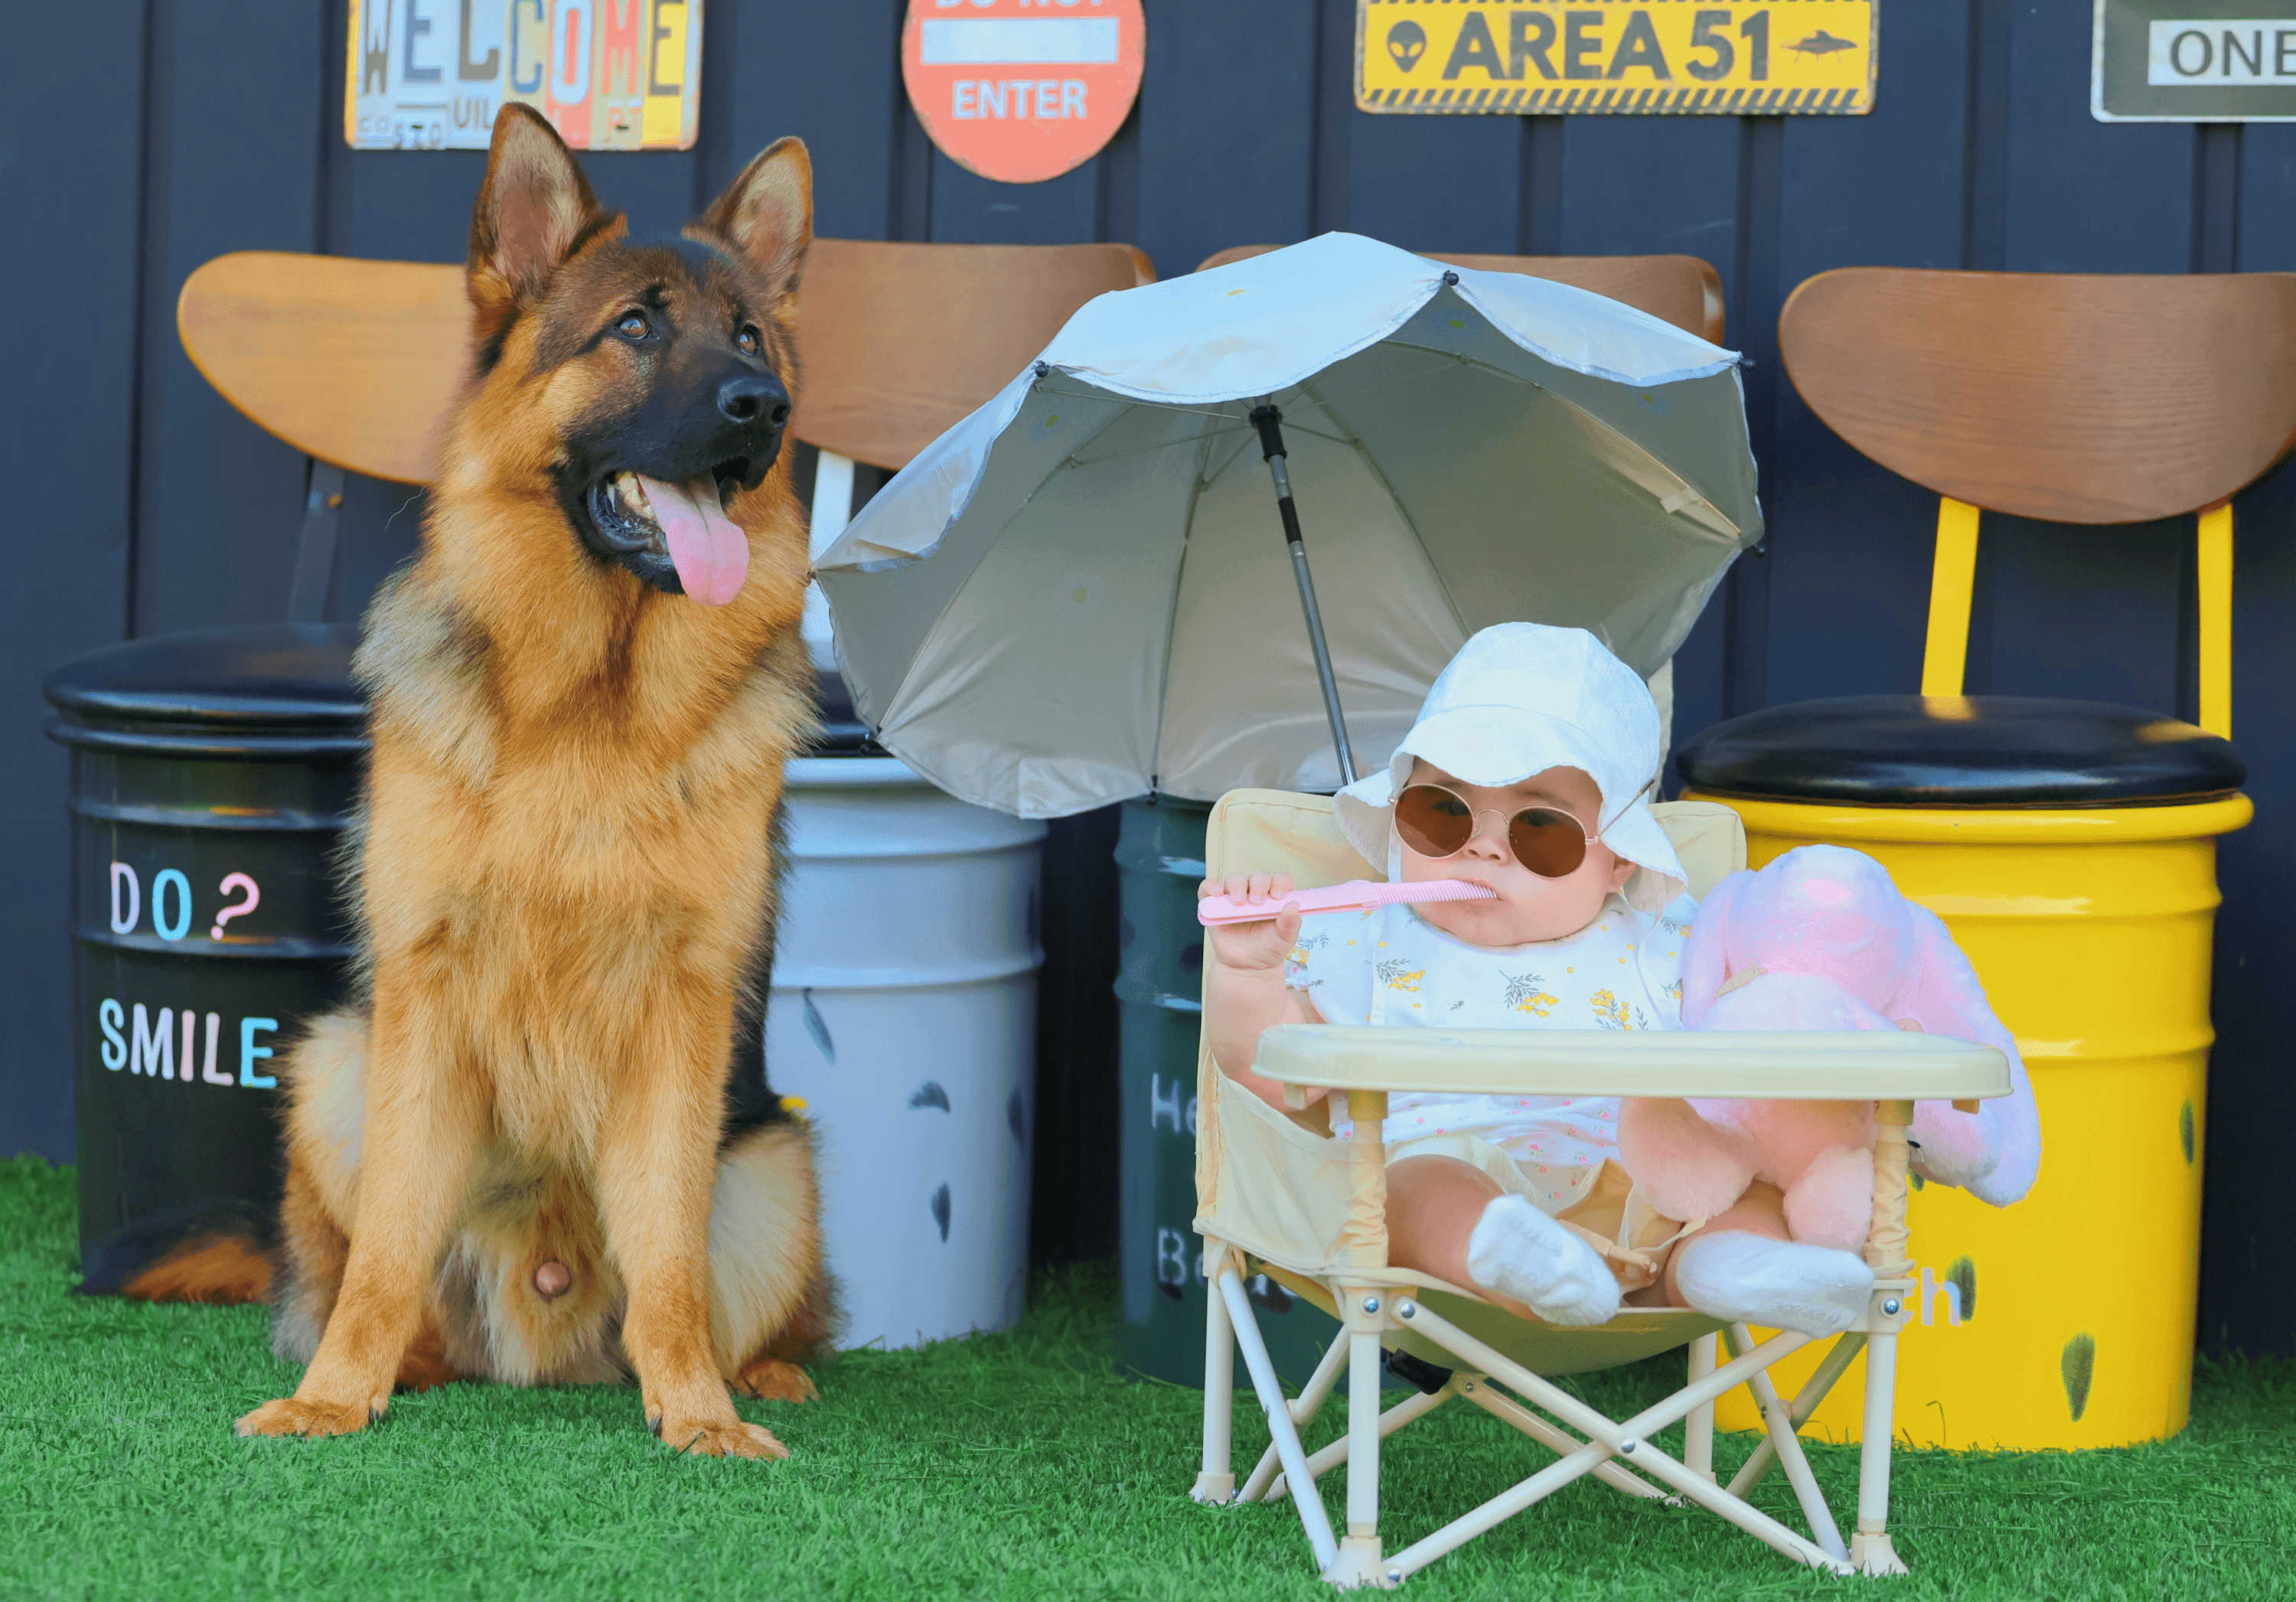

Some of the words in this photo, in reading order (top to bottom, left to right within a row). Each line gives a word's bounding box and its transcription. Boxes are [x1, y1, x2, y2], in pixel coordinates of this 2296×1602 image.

[363, 0, 686, 106] WELCOME
[1441, 10, 1672, 81] AREA
[1684, 9, 1769, 82] 51
[2170, 29, 2296, 77] ONE
[953, 80, 1088, 119] ENTER
[99, 997, 279, 1088] SMILE
